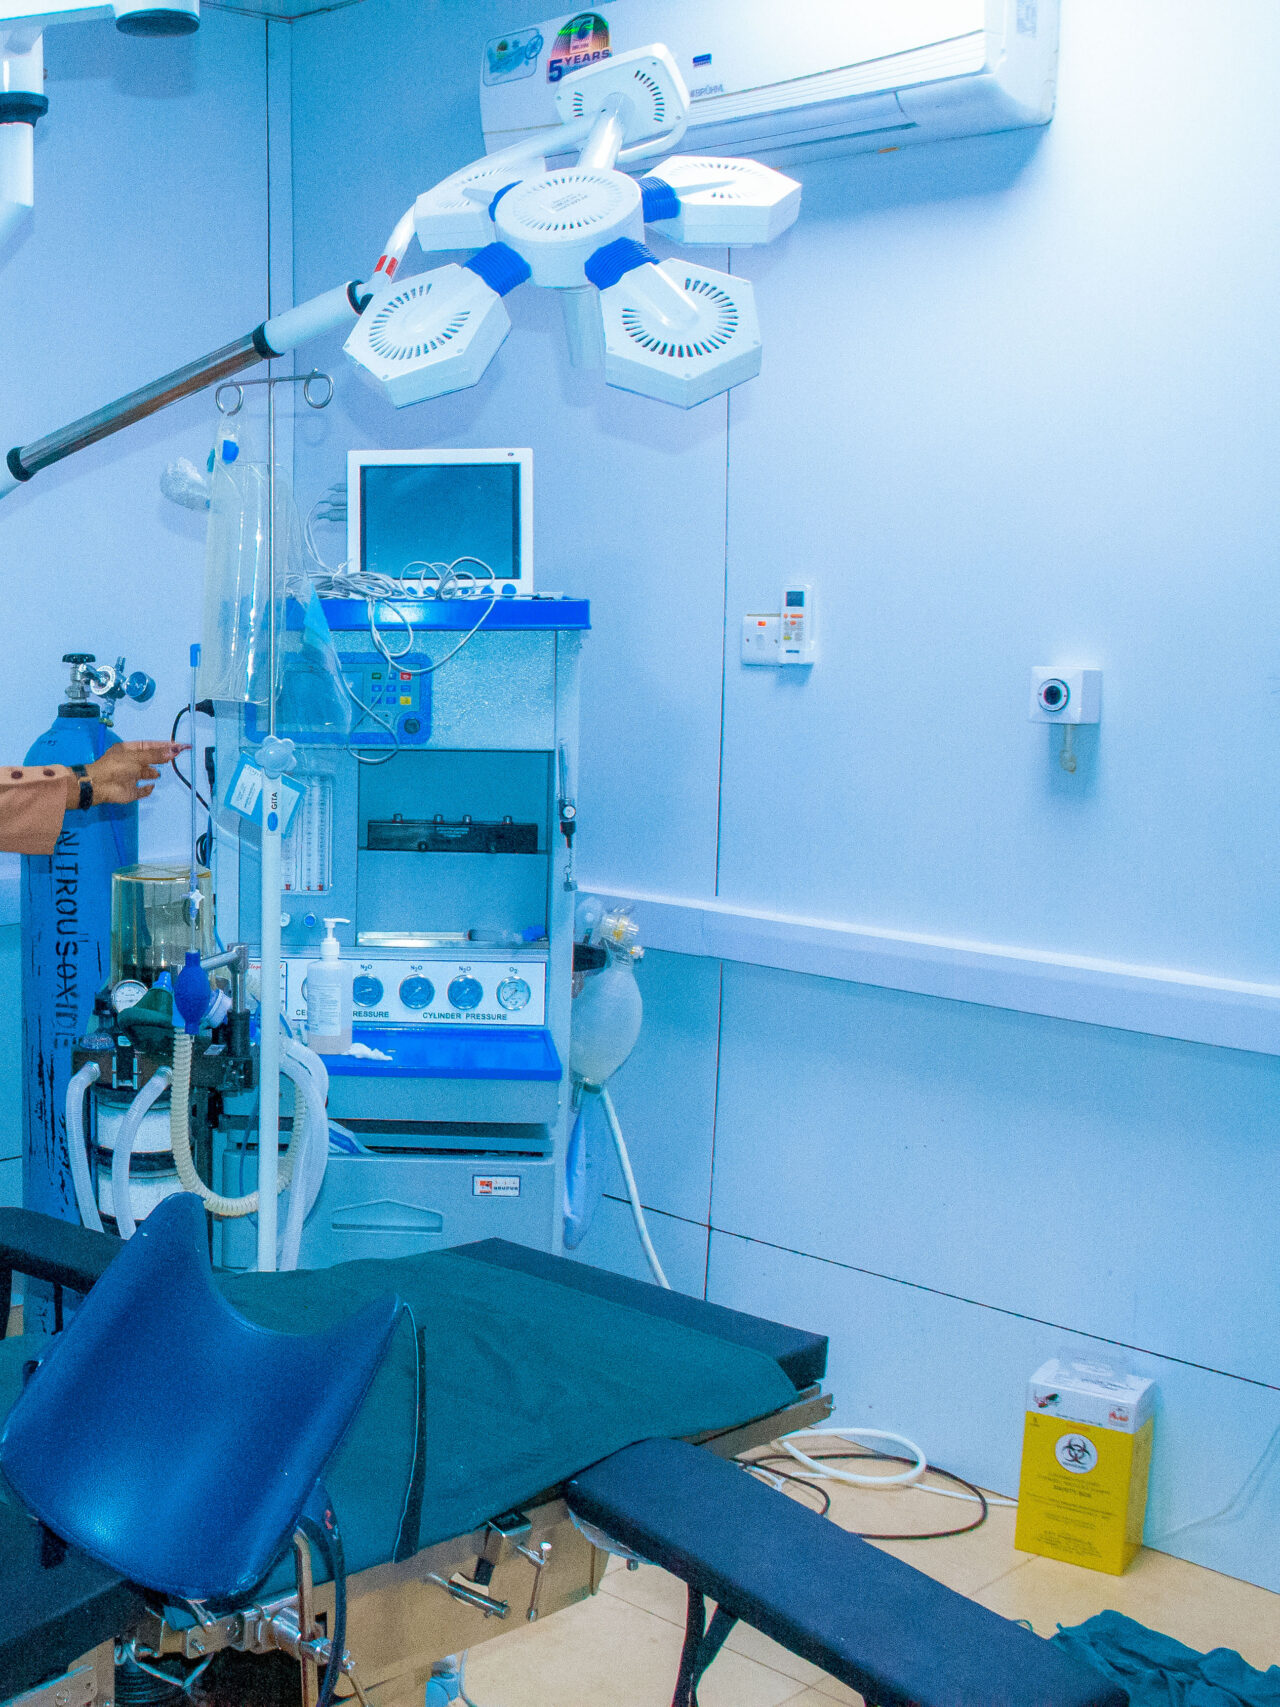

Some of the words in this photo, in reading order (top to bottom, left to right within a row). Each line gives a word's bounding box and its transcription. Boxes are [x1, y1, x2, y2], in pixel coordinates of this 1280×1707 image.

[549, 59, 562, 82] 5
[565, 49, 610, 65] YEARS
[352, 1010, 390, 1018] RESSURE
[422, 1011, 462, 1019] CYLINDER
[465, 1012, 508, 1021] PRESSURE
